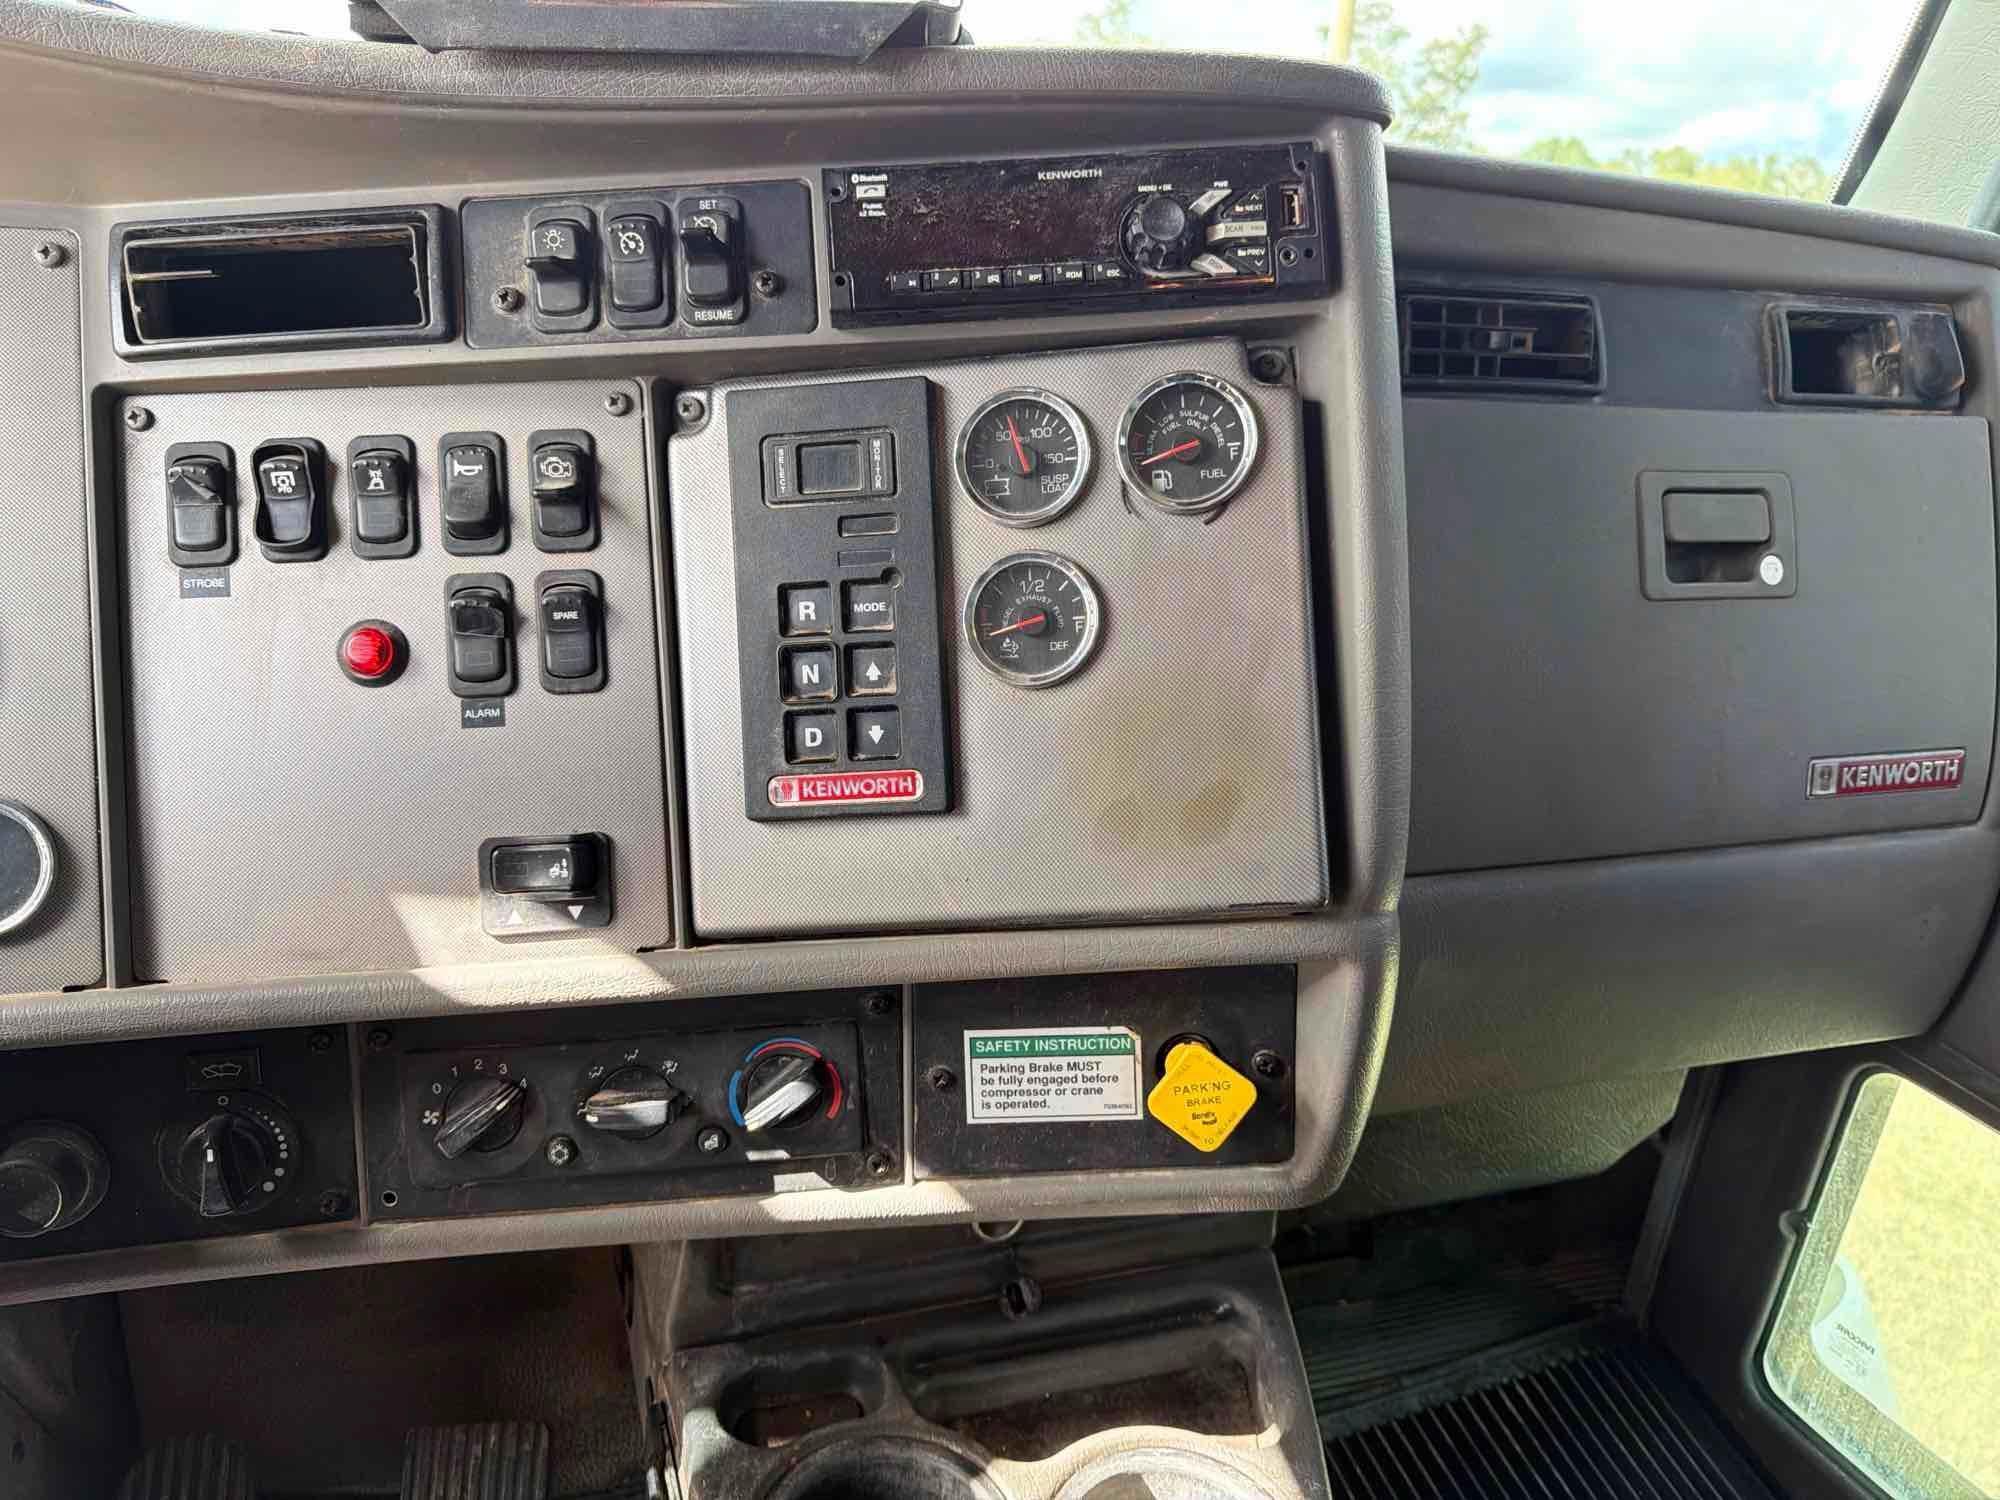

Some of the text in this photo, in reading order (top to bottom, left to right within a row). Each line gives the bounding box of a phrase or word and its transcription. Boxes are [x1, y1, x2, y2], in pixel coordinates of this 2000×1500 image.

[1037, 167, 1102, 180] KENWORTH
[699, 200, 717, 209] SET
[1245, 204, 1263, 212] NEXT
[1224, 224, 1244, 233] SCAN
[1246, 248, 1265, 256] PREV
[694, 310, 734, 321] RESUME
[1179, 409, 1209, 421] SULFUR
[995, 430, 1012, 442] 50
[1030, 426, 1053, 439] 100
[1041, 452, 1064, 464] 150
[1230, 446, 1239, 460] F
[872, 439, 882, 489] MONITOR
[777, 447, 786, 494] SELECT
[1200, 468, 1228, 479] FUEL
[1041, 473, 1070, 485] SUSP
[1041, 483, 1070, 493] LOAD
[183, 578, 226, 589] STROBE
[1019, 579, 1045, 594] 1/2
[799, 601, 816, 621] R
[853, 601, 888, 612] MODE
[552, 611, 579, 620] SPARE
[1075, 620, 1083, 633] F
[1049, 640, 1069, 651] DEF
[801, 663, 820, 684] N
[464, 708, 501, 719] ALARM
[804, 727, 823, 748] D
[1841, 759, 1960, 788] KENWORTH
[802, 778, 913, 798] KENWORTH
[975, 1038, 1132, 1053] SAFETY INSTRUCTION
[474, 1058, 483, 1070] 2
[499, 1063, 508, 1074] 3
[980, 1061, 1102, 1075] Parking Brake MUST
[451, 1065, 458, 1077] 1
[520, 1077, 528, 1089] 4
[980, 1073, 1119, 1087] be fully engaged before
[432, 1082, 442, 1095] 0
[981, 1086, 1104, 1099] compressor or crane
[1173, 1080, 1232, 1097] PARKING
[981, 1099, 1050, 1111] is operated.
[1186, 1095, 1222, 1107] BRAKE
